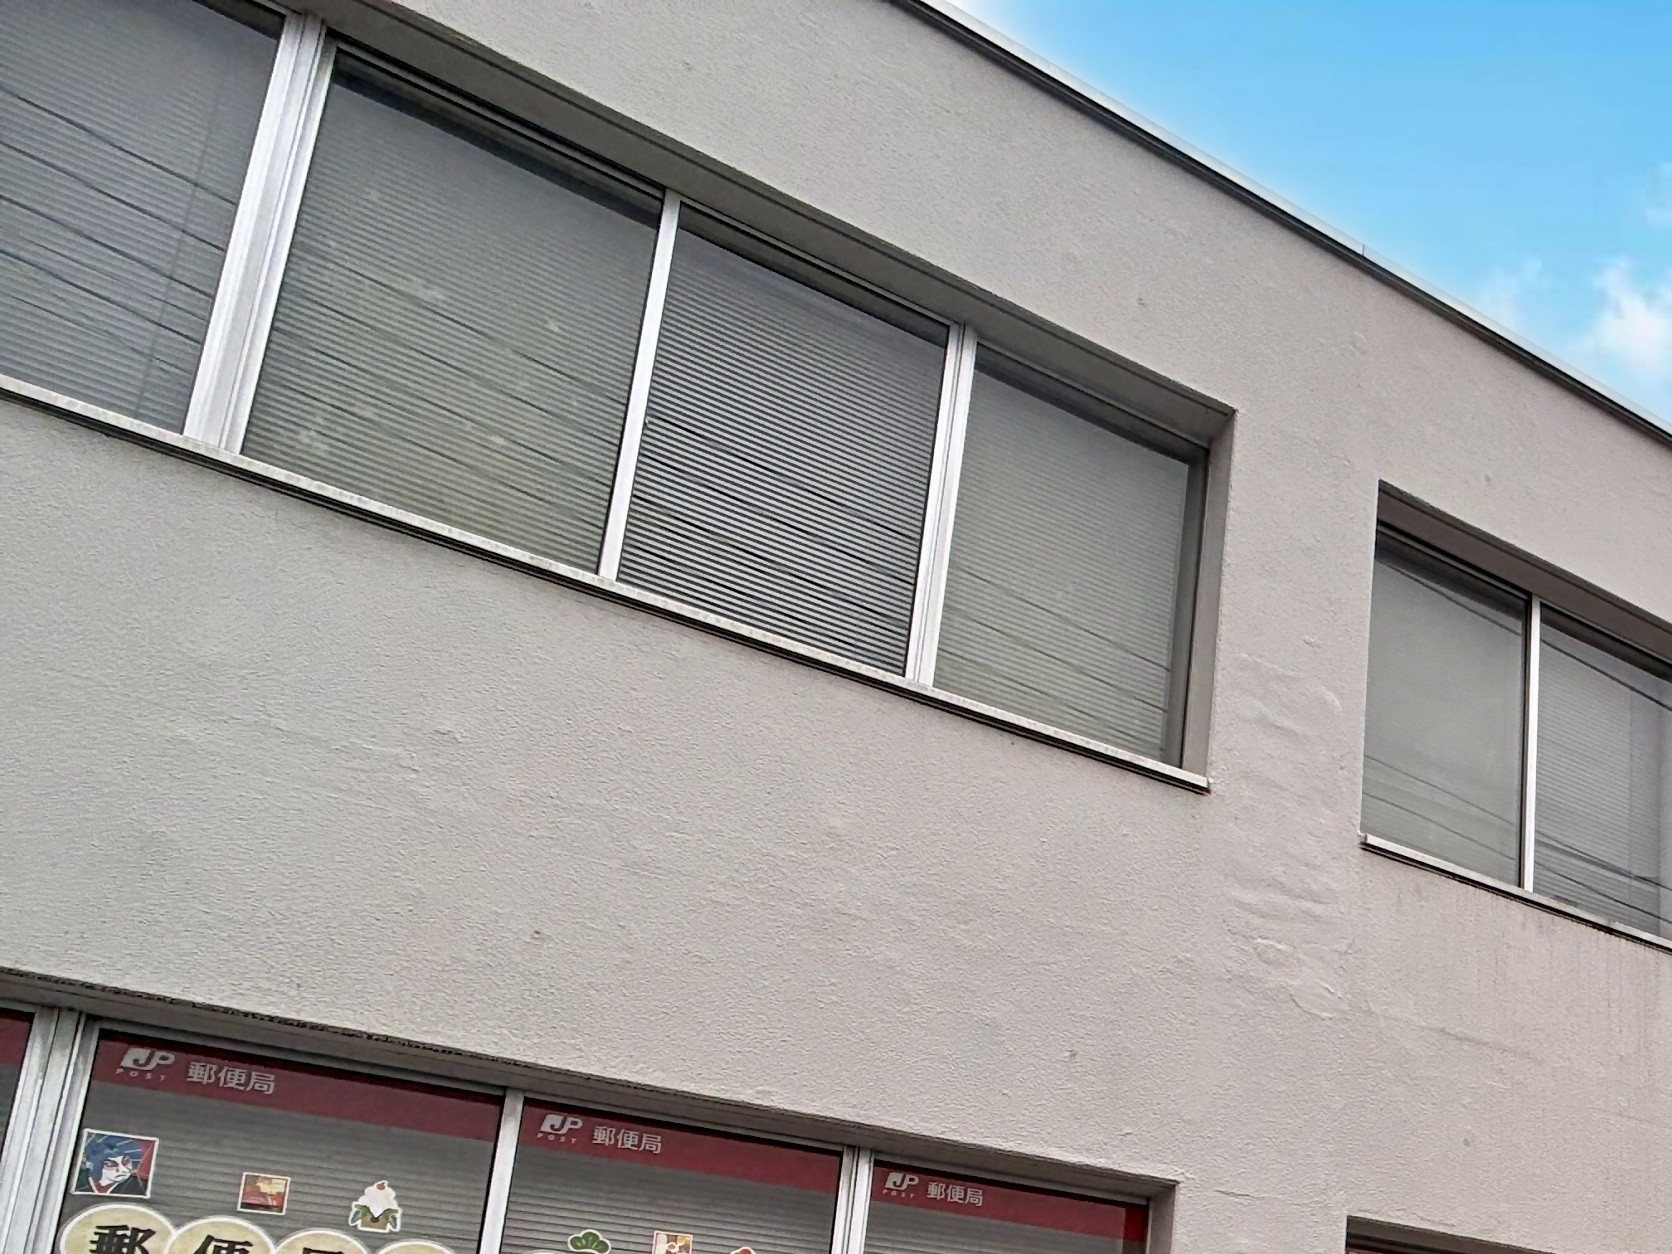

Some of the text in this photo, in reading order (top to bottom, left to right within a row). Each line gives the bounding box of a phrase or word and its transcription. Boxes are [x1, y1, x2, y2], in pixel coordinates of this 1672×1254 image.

[186, 1061, 275, 1094] 郵便局
[592, 1126, 662, 1154] 郵便局
[926, 1182, 983, 1207] 郵便局
